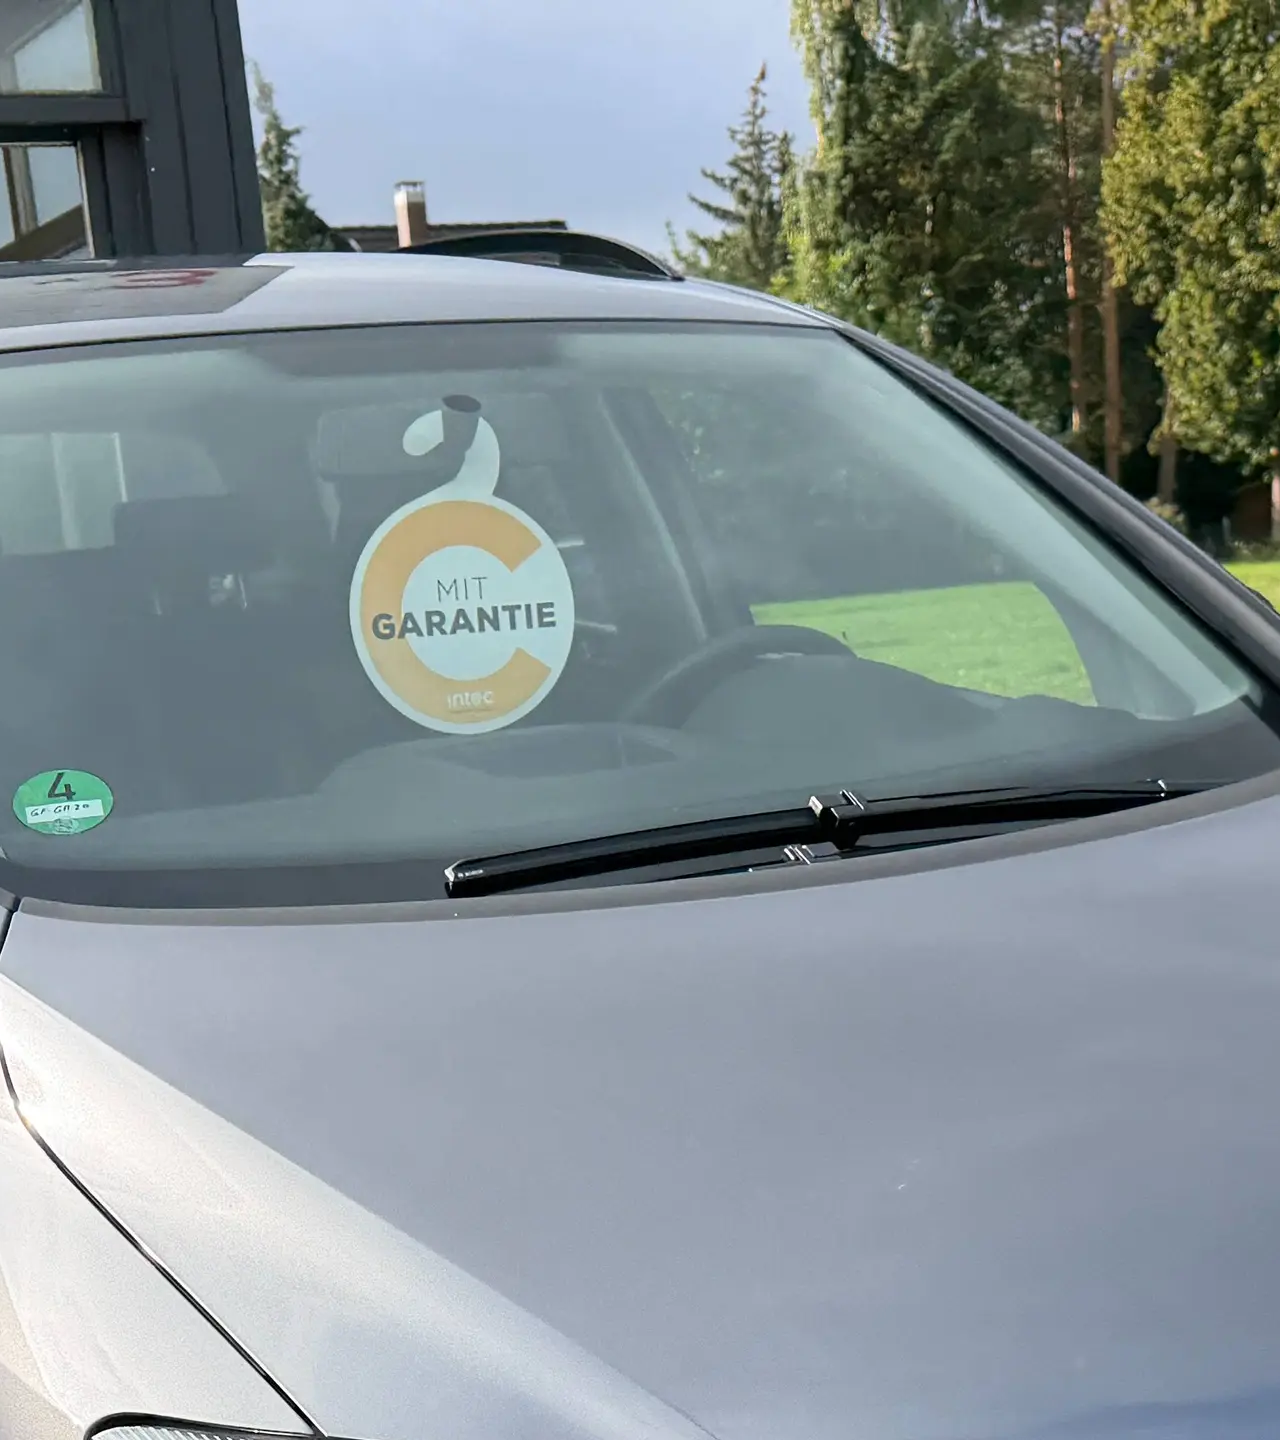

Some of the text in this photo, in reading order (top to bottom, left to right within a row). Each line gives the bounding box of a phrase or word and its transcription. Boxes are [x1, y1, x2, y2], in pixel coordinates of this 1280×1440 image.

[437, 576, 488, 602] MIT
[372, 602, 557, 640] GARANTIE
[48, 772, 77, 800] 4
